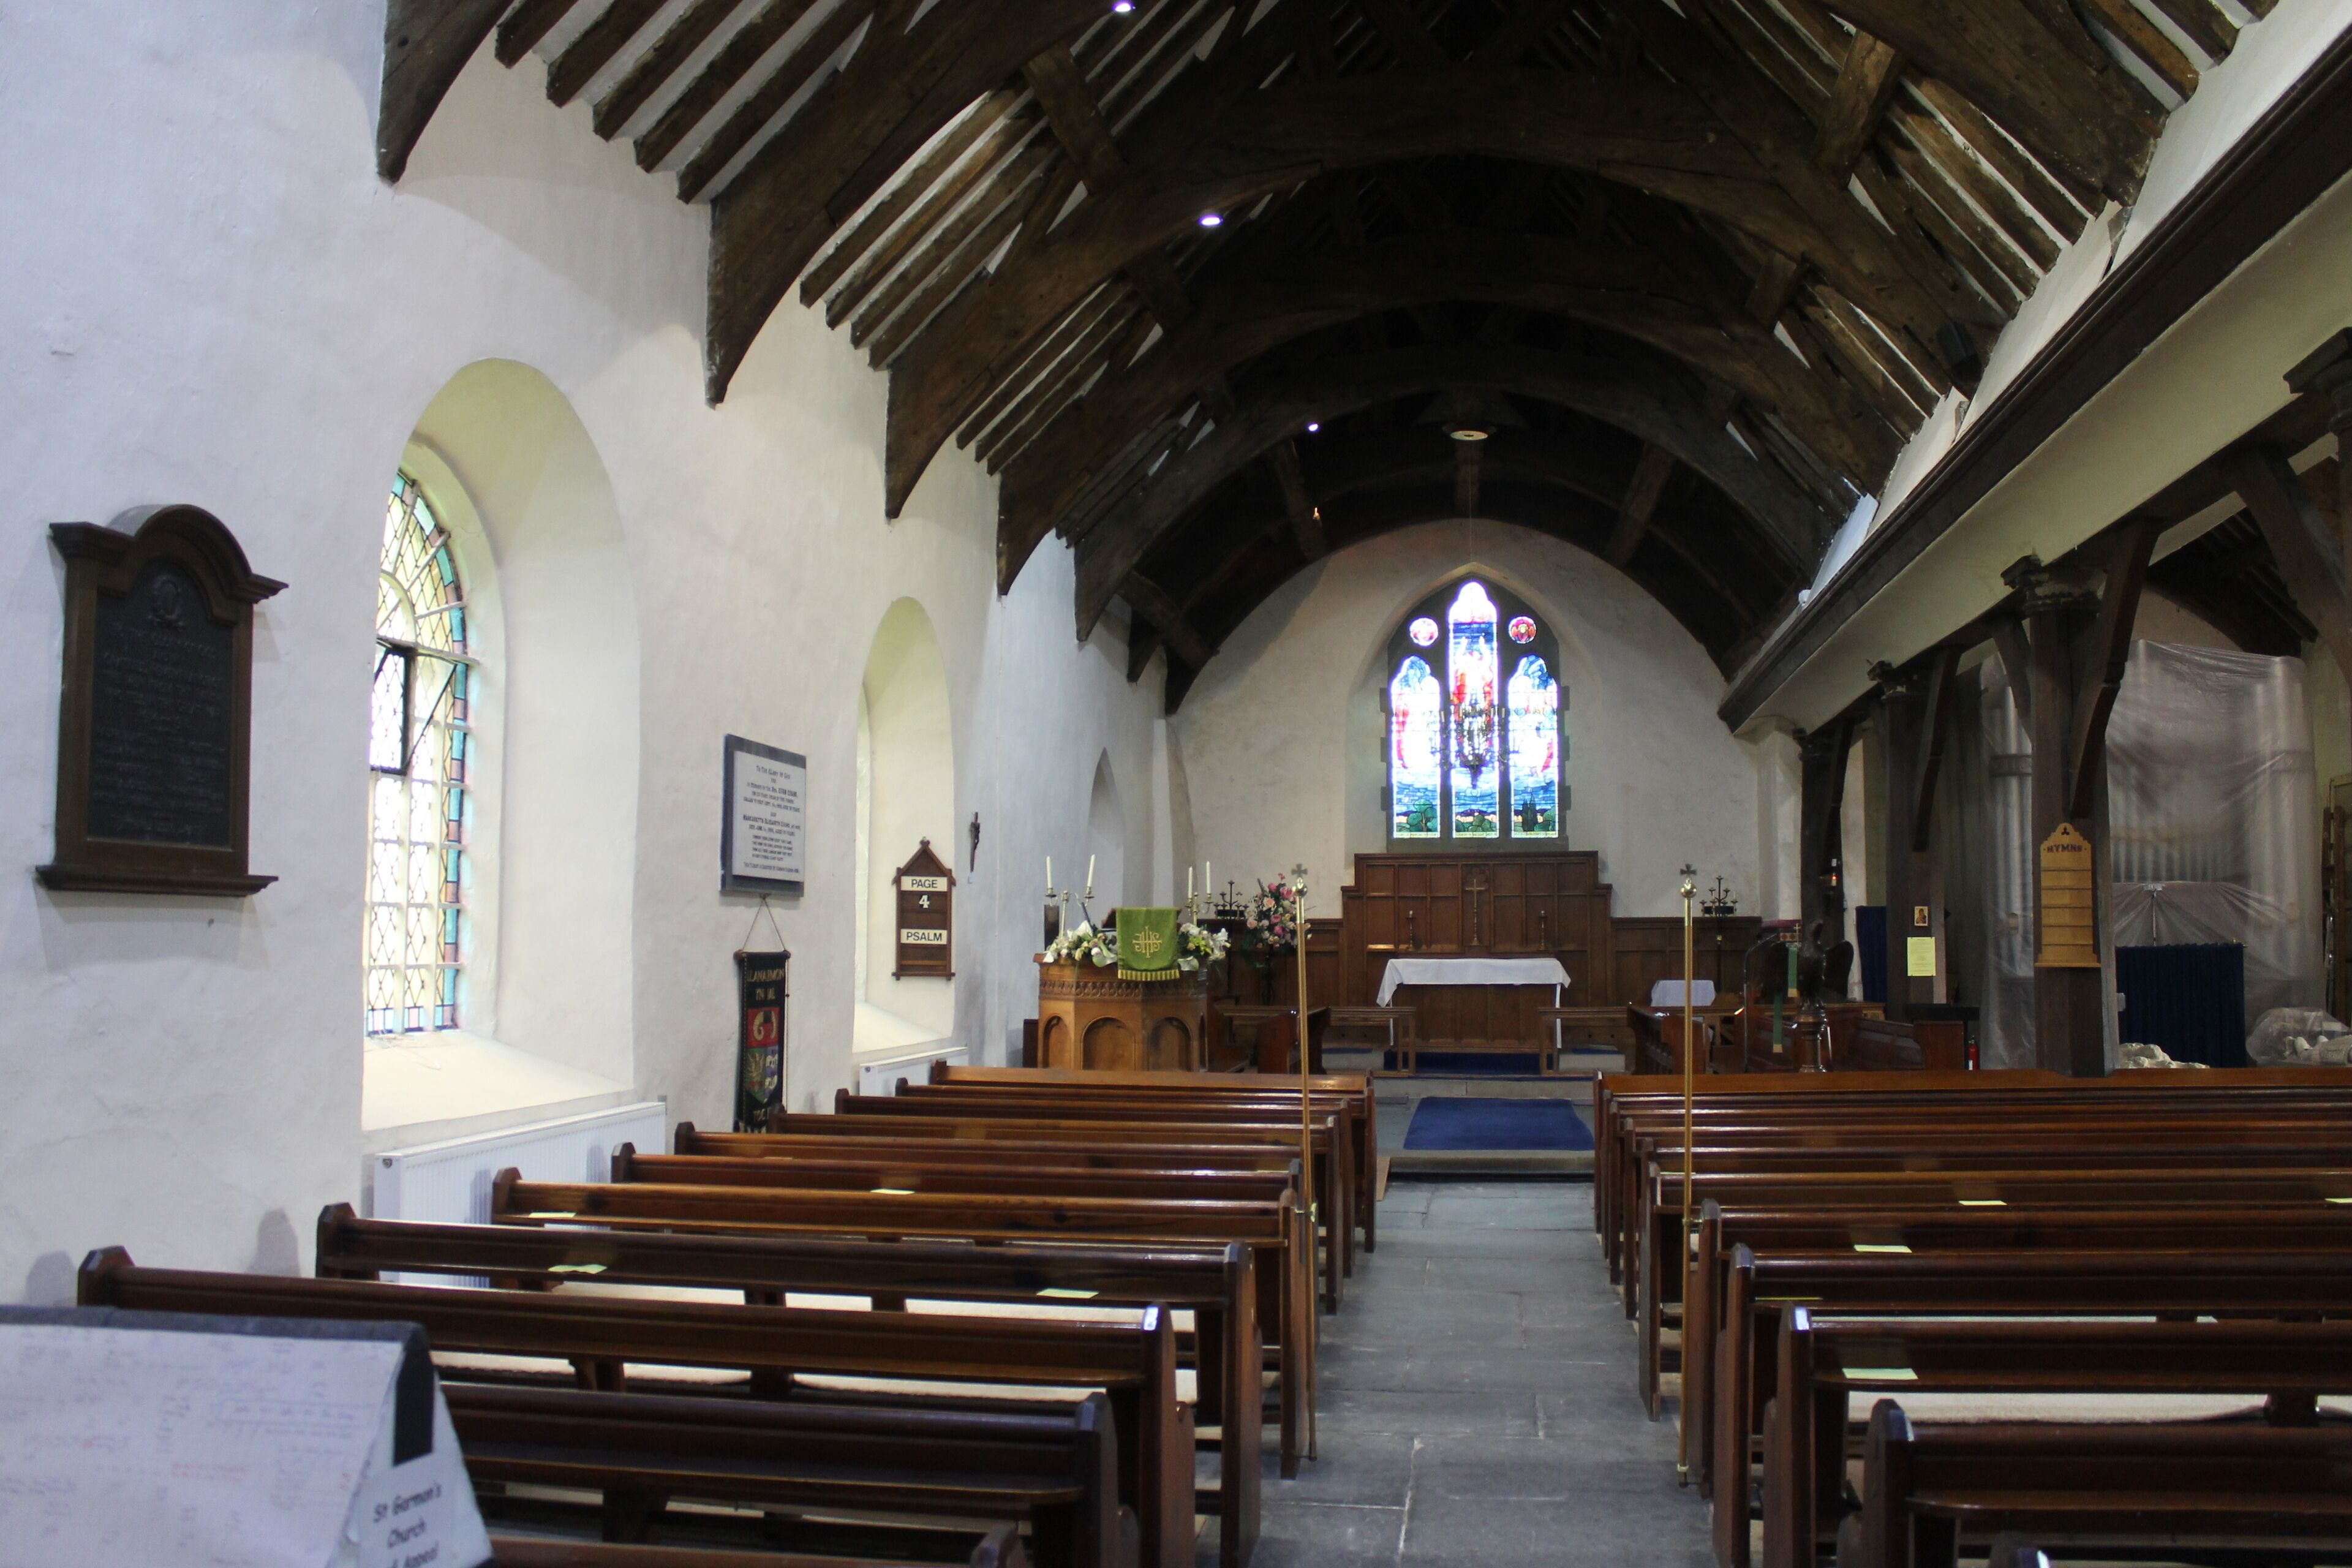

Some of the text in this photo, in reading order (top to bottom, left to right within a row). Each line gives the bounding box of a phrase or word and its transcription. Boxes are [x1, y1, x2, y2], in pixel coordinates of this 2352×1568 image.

[2047, 844, 2082, 853] HYMNS
[911, 879, 938, 888] PAGE
[919, 895, 930, 908] 4
[907, 932, 942, 941] PSALM
[373, 1502, 388, 1523] St
[387, 1517, 426, 1549] Church
